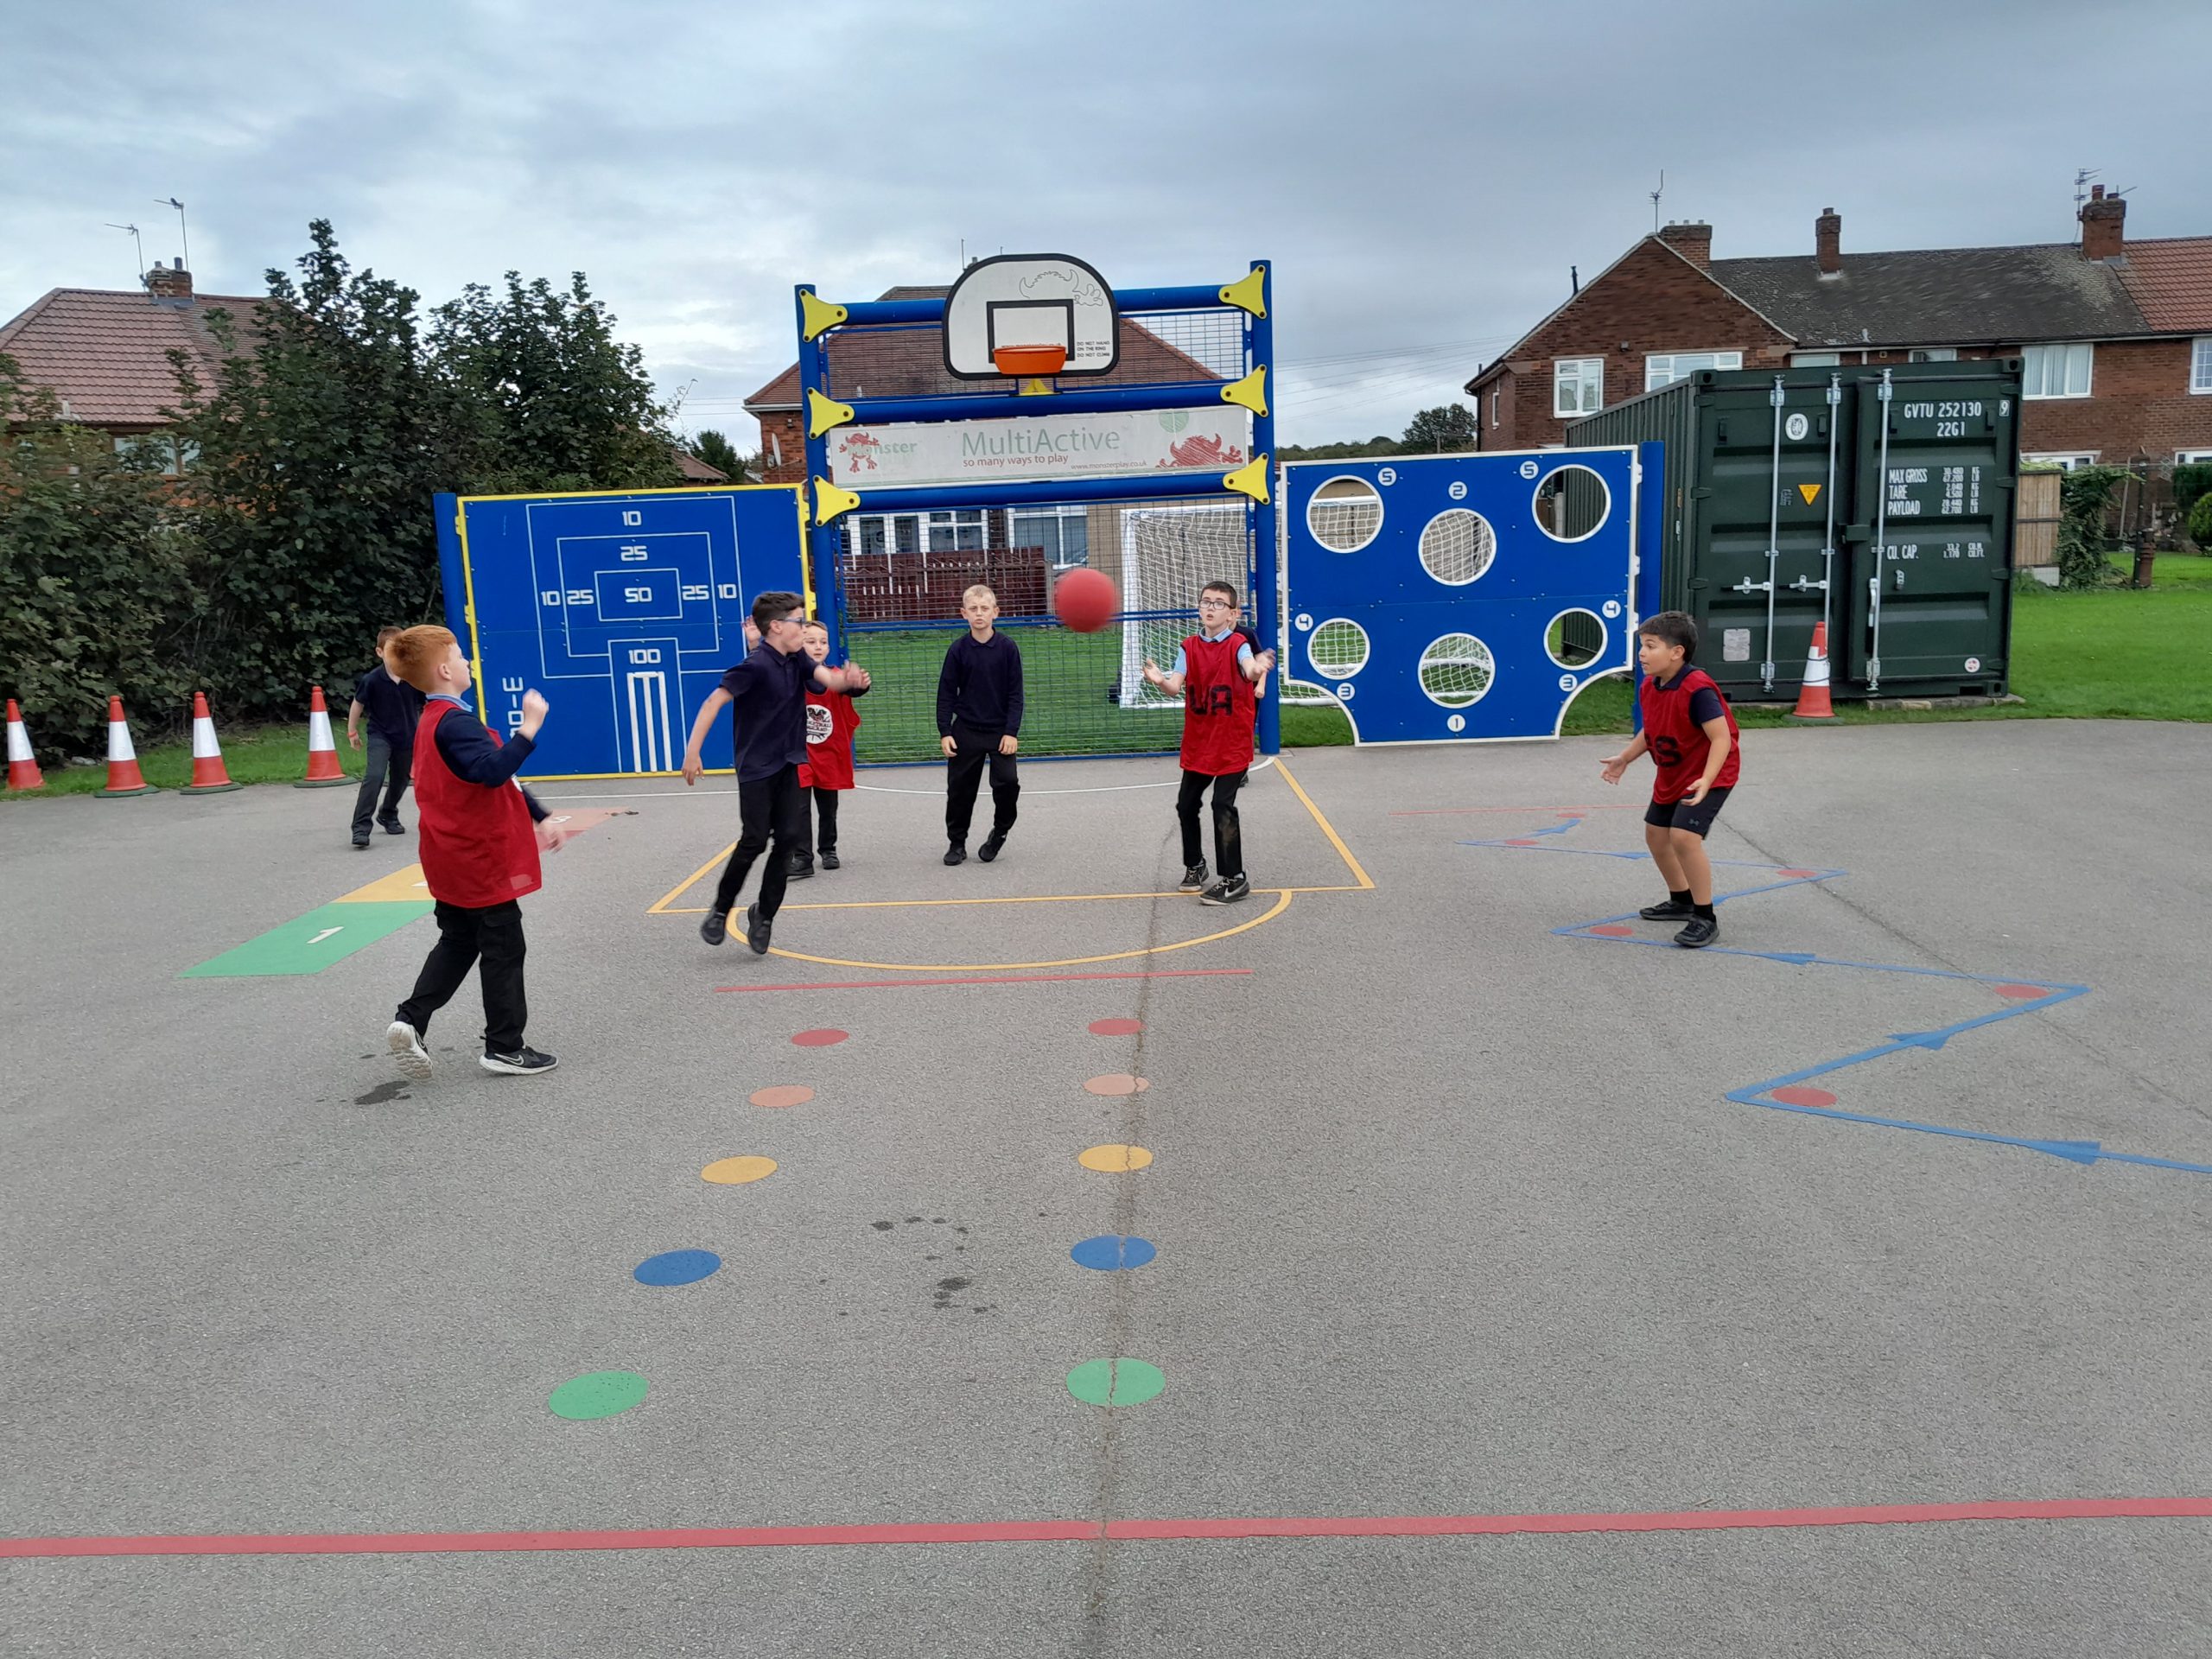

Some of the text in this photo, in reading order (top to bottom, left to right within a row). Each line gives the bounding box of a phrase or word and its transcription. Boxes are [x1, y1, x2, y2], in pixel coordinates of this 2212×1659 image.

[1904, 401, 2010, 418] GVTU 252130 9
[1936, 421, 1966, 437] 22G1
[962, 427, 1121, 457] MultiActive
[963, 453, 1069, 468] so many ways to play
[1382, 471, 1393, 483] 5
[1523, 465, 1535, 476] 5
[1888, 469, 1904, 484] MAX
[1905, 467, 1928, 483] GROSS
[1452, 485, 1463, 497] 2
[1889, 485, 1909, 499] TARE
[1887, 500, 1921, 516] PAYLOAD
[622, 511, 642, 526] 10
[620, 545, 648, 562] 25
[1901, 544, 1919, 560] CAP.
[541, 590, 562, 606] 10
[566, 589, 594, 605] 25
[624, 587, 652, 603] 50
[681, 585, 710, 601] 25
[717, 583, 738, 600] 10
[1606, 604, 1617, 614] 4
[1299, 617, 1310, 627] 4
[628, 648, 662, 664] 100
[1562, 677, 1573, 688] 3
[1340, 686, 1351, 697] 3
[306, 925, 345, 944] 1
